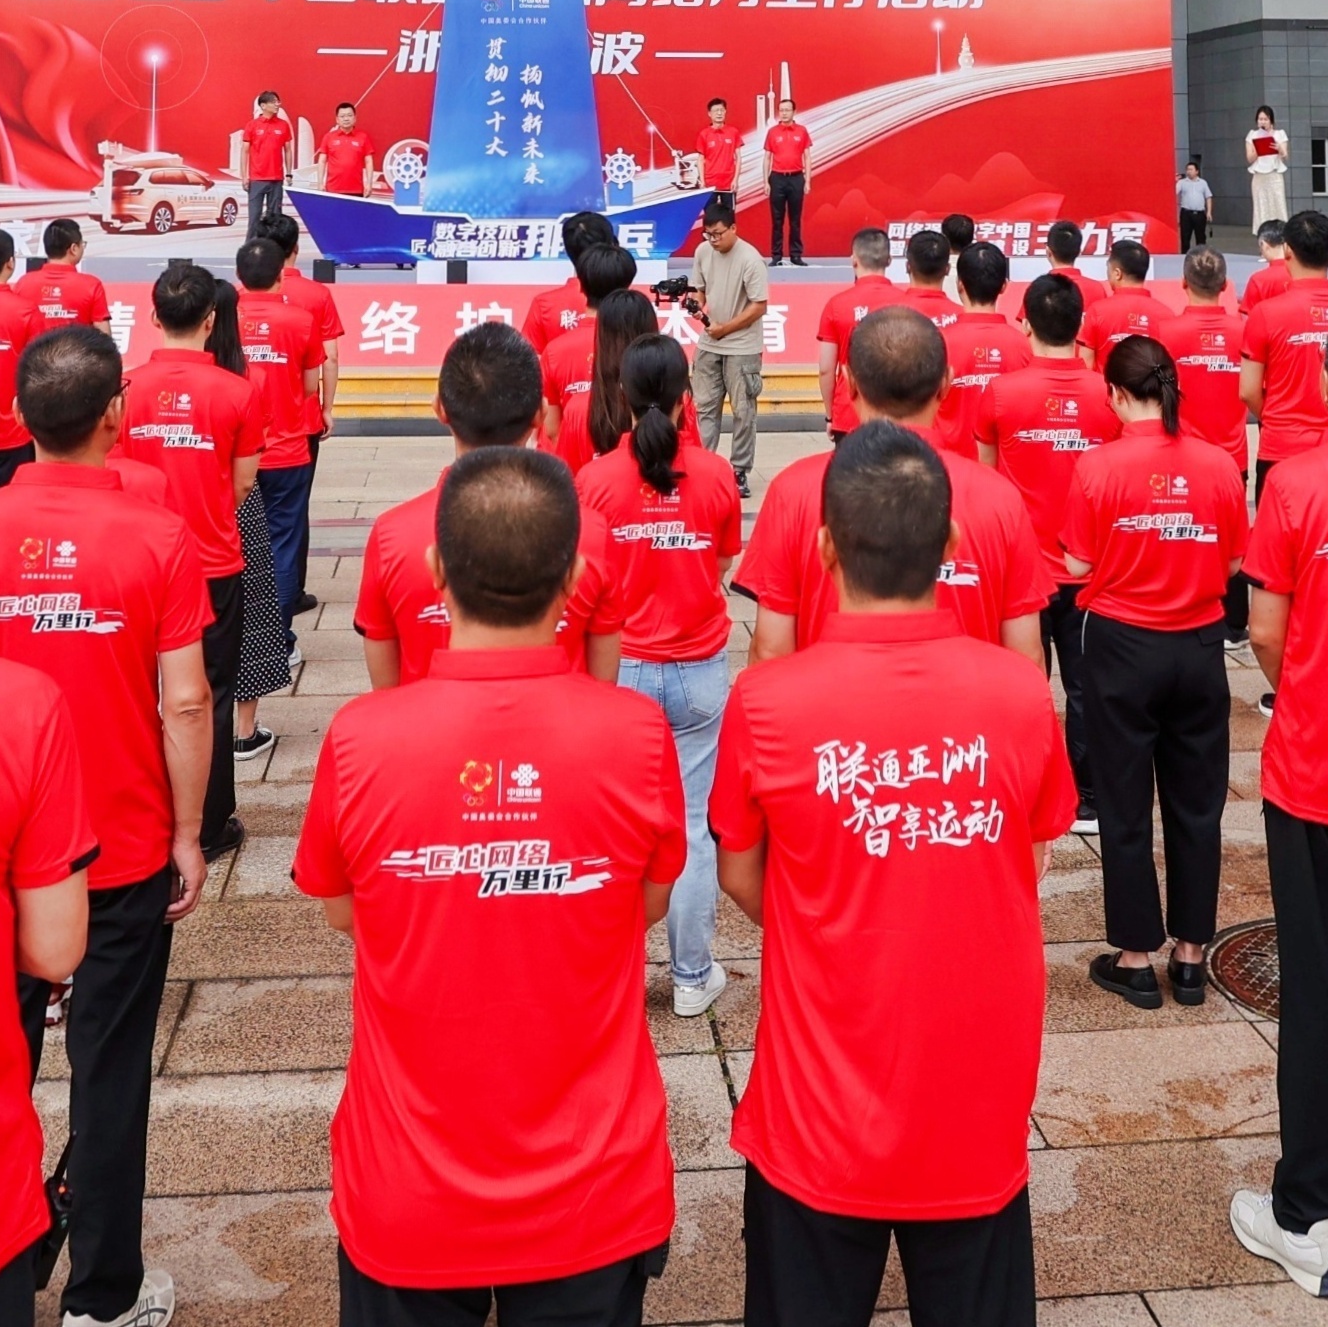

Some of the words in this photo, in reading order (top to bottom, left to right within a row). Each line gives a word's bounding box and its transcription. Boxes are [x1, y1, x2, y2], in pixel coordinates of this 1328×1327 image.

[484, 37, 509, 158] 贯彻二十大
[519, 64, 545, 185] 扬帆新未来
[145, 424, 193, 437] 匠心网络
[1032, 429, 1082, 441] 匠心网络
[163, 434, 203, 447] 万里行
[1053, 439, 1089, 451] 万里行
[625, 521, 685, 540] 匠心网络
[1135, 513, 1193, 529] 匠心网络
[651, 534, 696, 549] 万里行
[1159, 525, 1204, 540] 万里行
[31, 611, 96, 633] 万里行
[813, 734, 990, 804] 联通亚洲
[843, 793, 1004, 858] 智享运动
[425, 840, 550, 875] 匠心网络
[478, 863, 571, 898] 万里行
